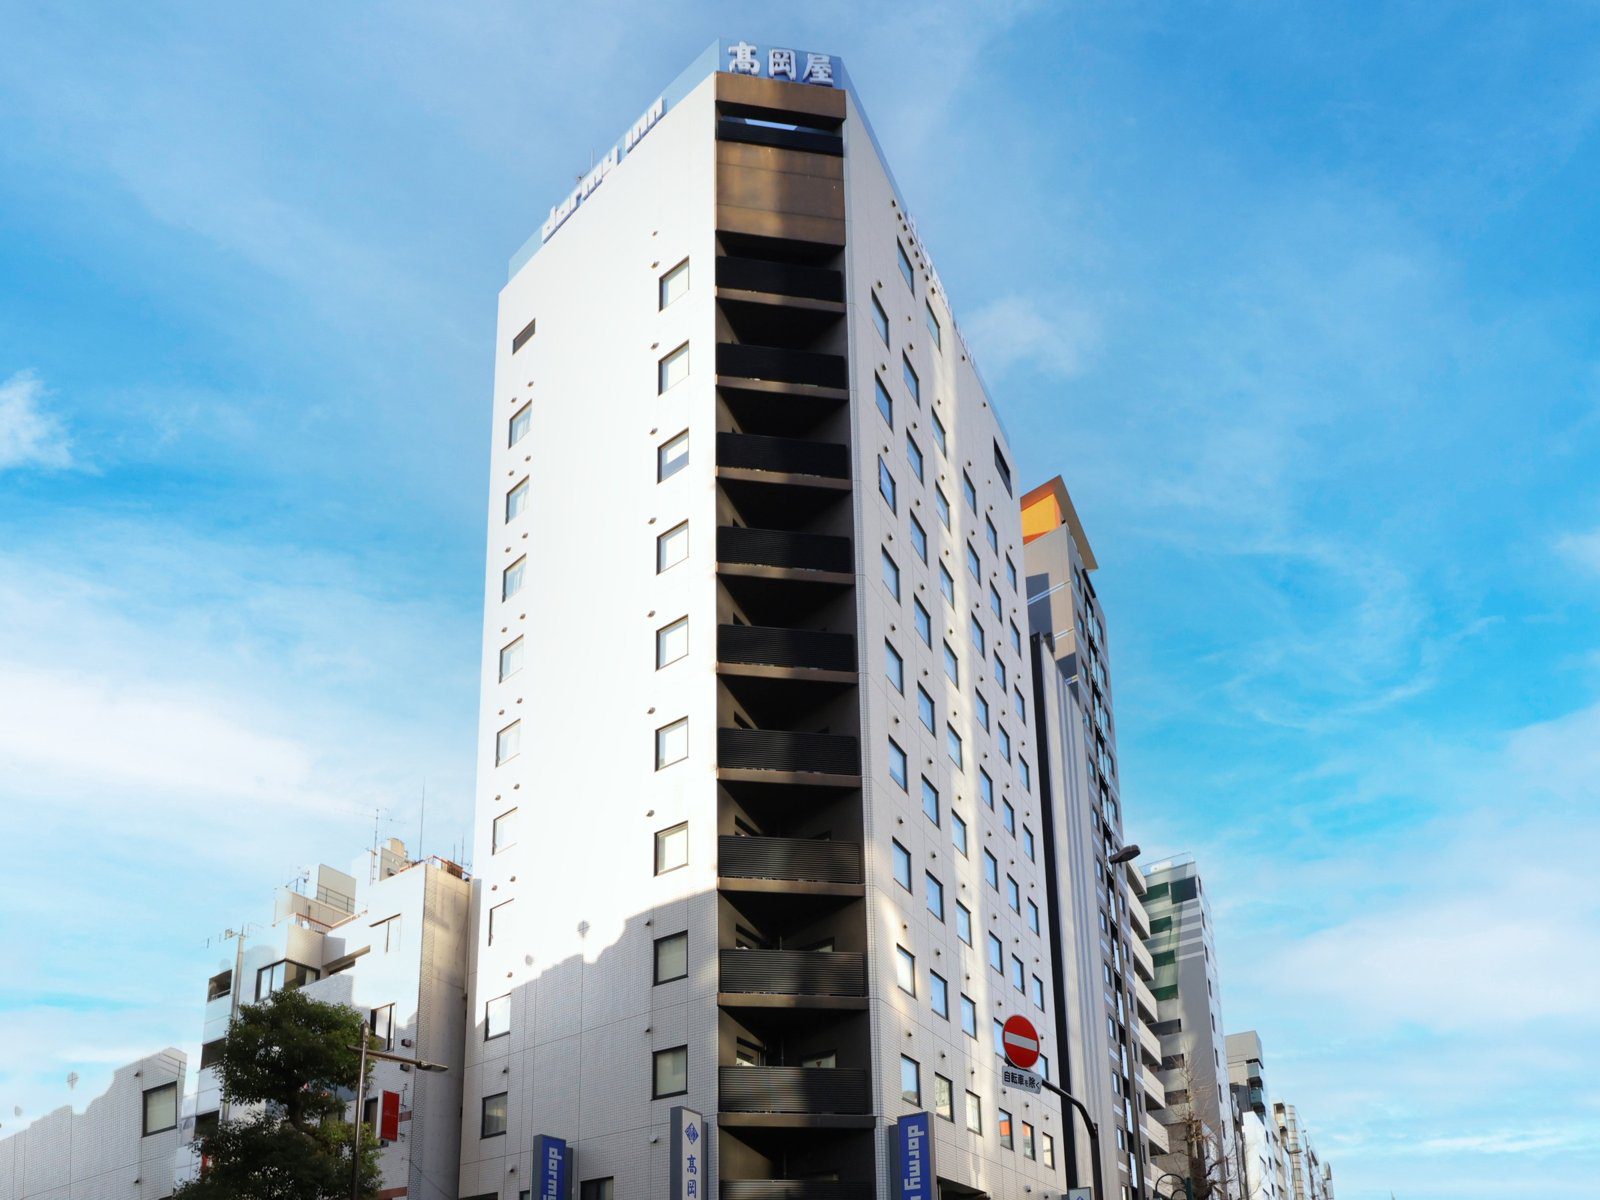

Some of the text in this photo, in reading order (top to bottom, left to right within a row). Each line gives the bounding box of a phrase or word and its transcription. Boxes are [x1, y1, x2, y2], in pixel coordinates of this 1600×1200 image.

[1003, 1071, 1041, 1090] 自転車を除く
[903, 1124, 925, 1191] dormy
